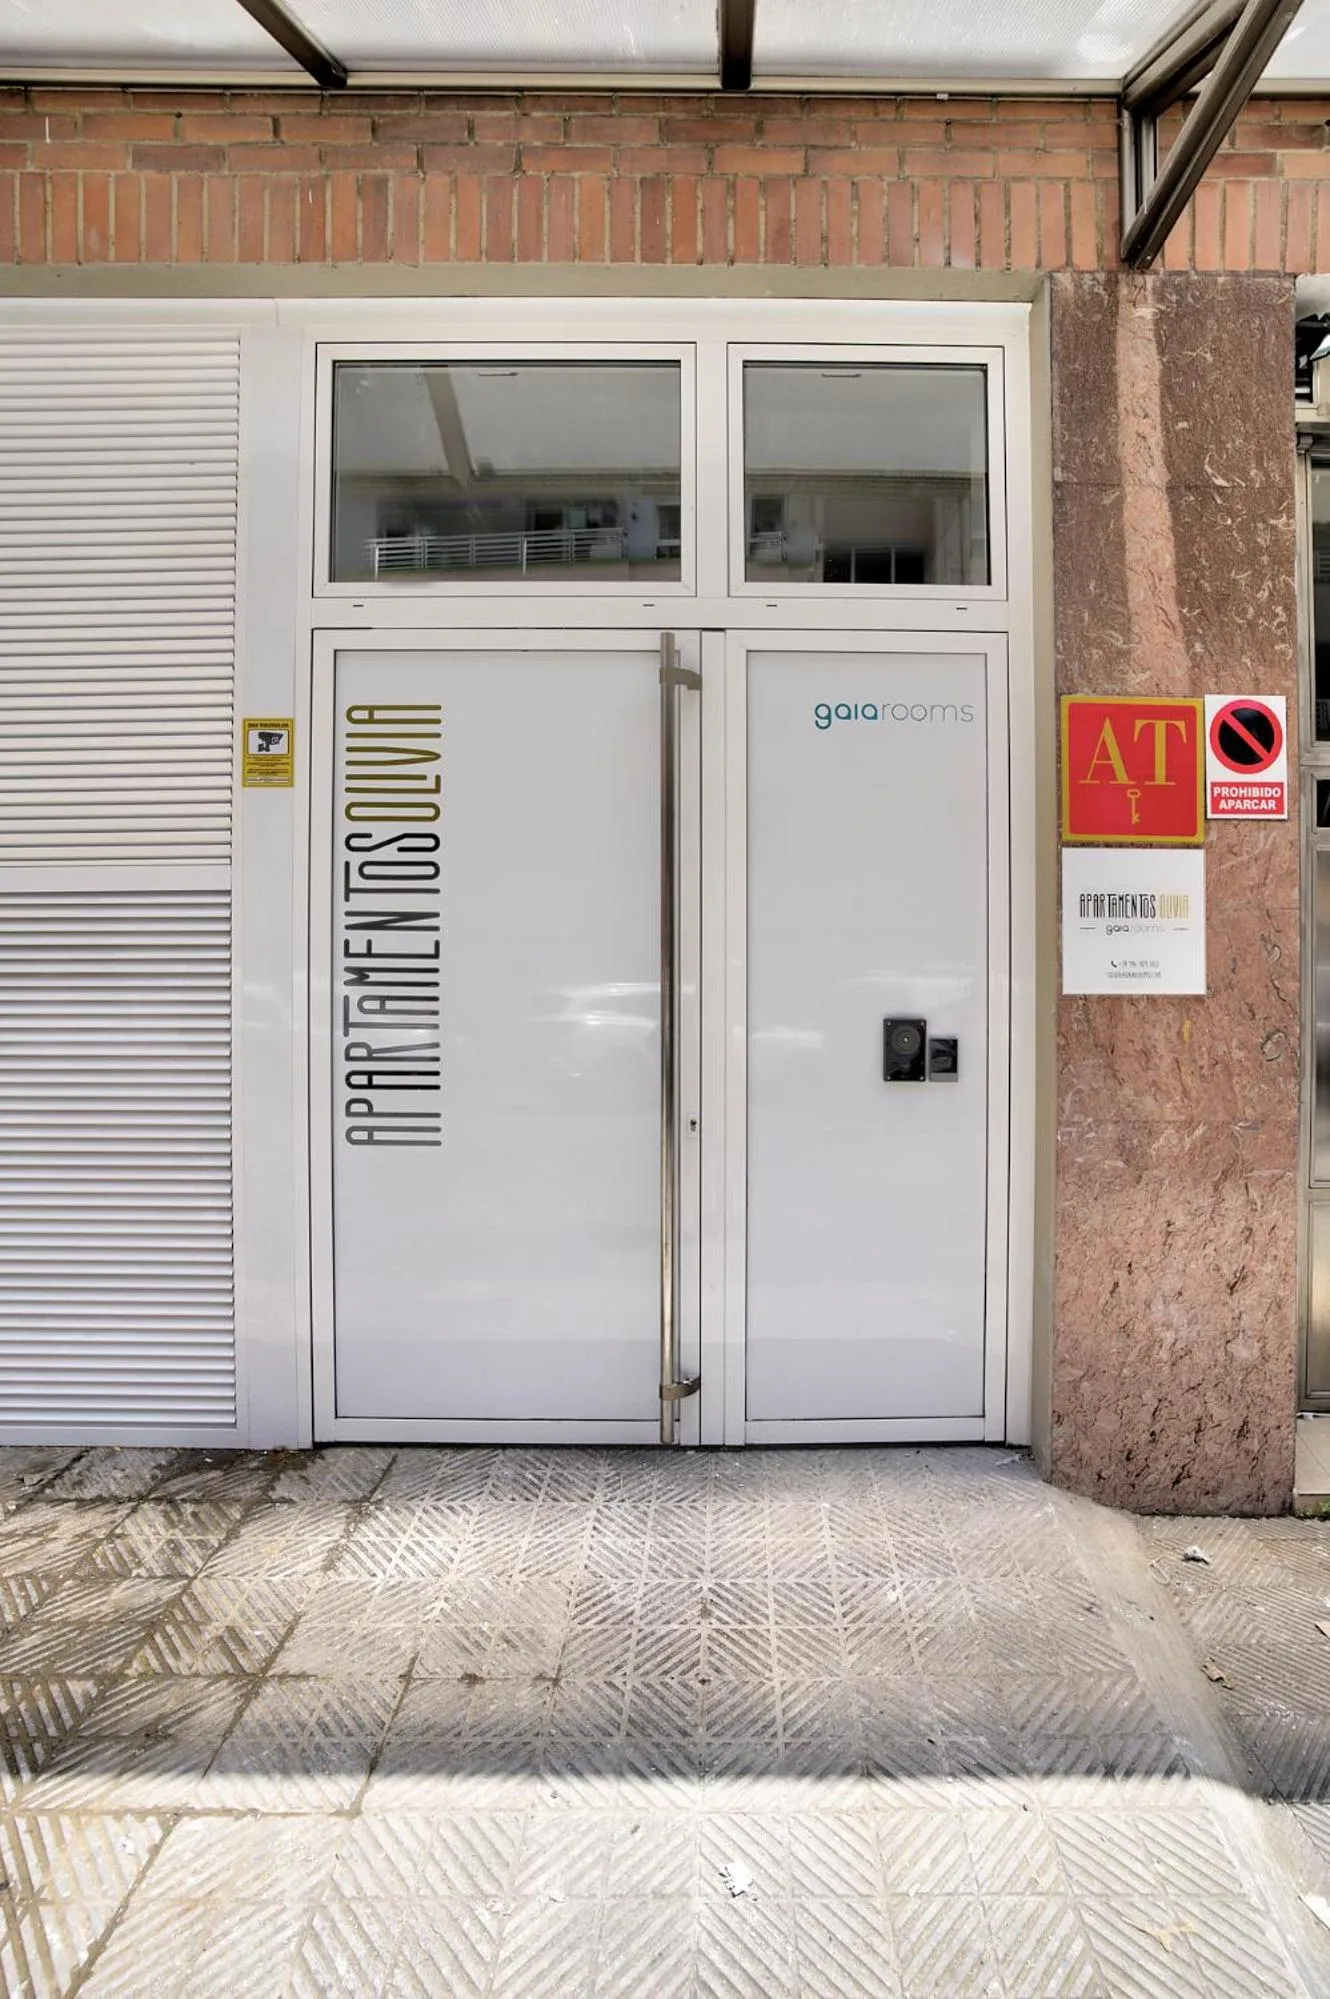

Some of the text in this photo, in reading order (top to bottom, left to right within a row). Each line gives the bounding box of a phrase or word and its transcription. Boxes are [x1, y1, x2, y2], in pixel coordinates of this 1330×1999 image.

[814, 703, 974, 730] gaiarooms
[1077, 717, 1187, 786] AT
[1213, 786, 1282, 798] PROHIBIDO
[1218, 799, 1276, 811] APARCAR
[1079, 893, 1156, 919] APARTAMENTOS
[343, 704, 442, 1147] APARTAMENTOS OLIVIA
